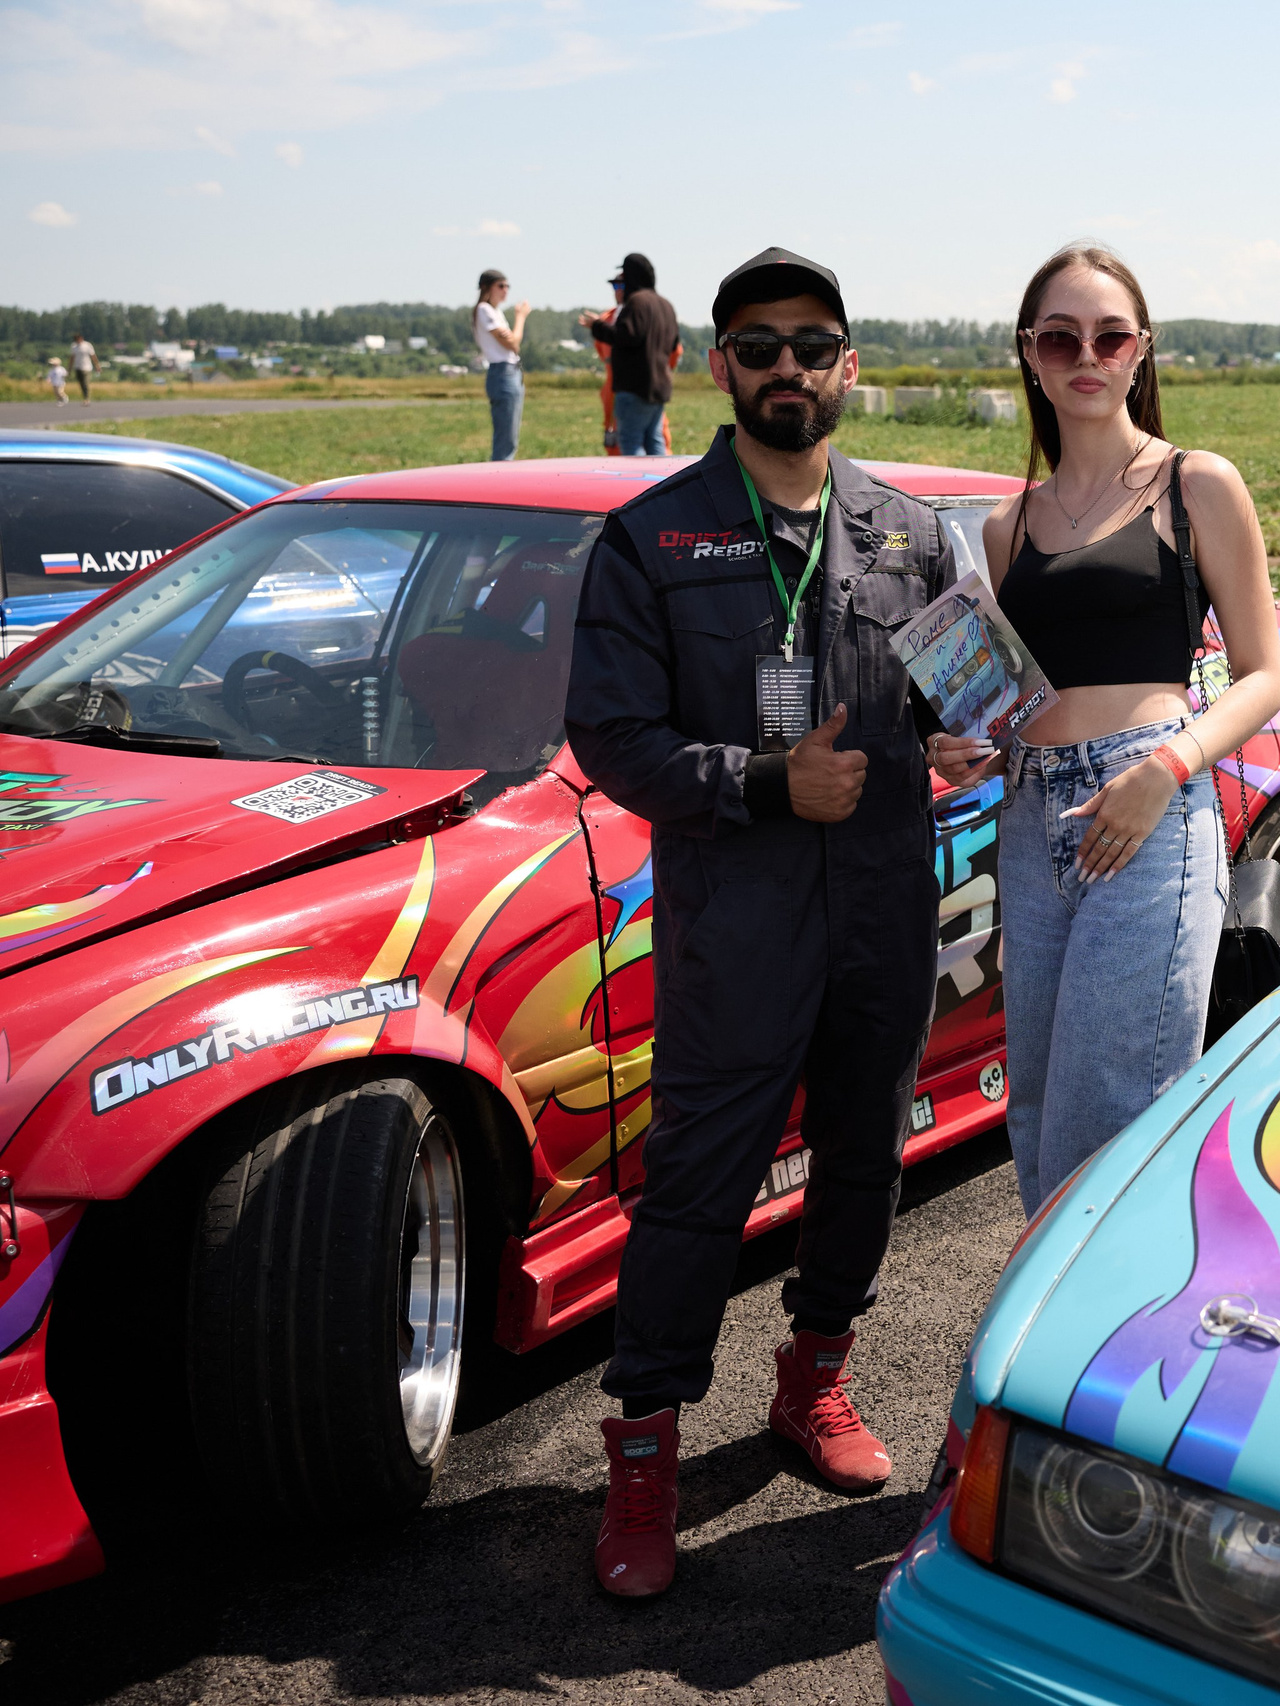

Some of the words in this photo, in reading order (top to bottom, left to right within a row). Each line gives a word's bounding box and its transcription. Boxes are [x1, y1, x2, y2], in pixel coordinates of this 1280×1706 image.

[658, 530, 733, 548] DRIFT
[693, 540, 770, 560] READY
[1008, 685, 1046, 729] READY
